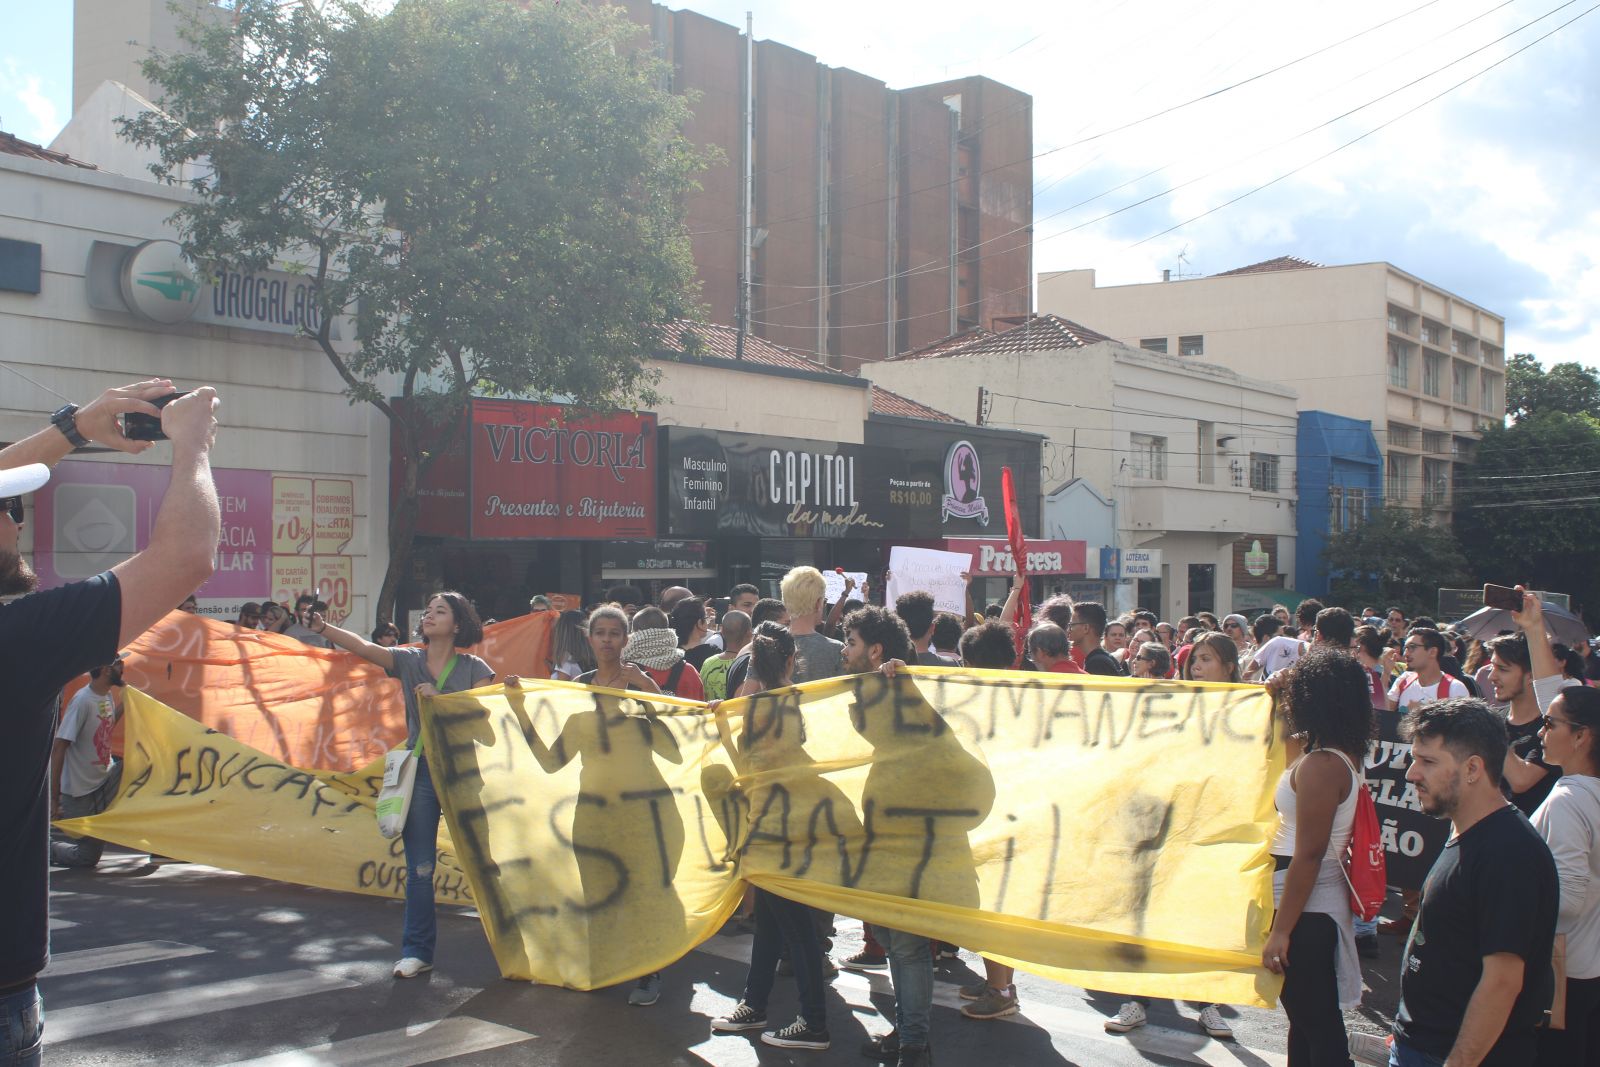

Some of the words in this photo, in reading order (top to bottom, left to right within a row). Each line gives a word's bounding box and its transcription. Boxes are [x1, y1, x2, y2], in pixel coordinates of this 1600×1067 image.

[484, 423, 647, 482] VICTORIA
[683, 457, 727, 472] Masculino
[683, 476, 722, 491] Feminino
[769, 449, 859, 507] CAPITAL
[889, 478, 905, 487] Peças
[910, 480, 924, 488] partir
[316, 496, 351, 504] COBRIMOS
[683, 496, 716, 511] Infantil
[484, 495, 560, 517] Presentes
[566, 506, 575, 517] e
[578, 497, 646, 523] Bijuteria
[1125, 565, 1149, 574] PAULISTA
